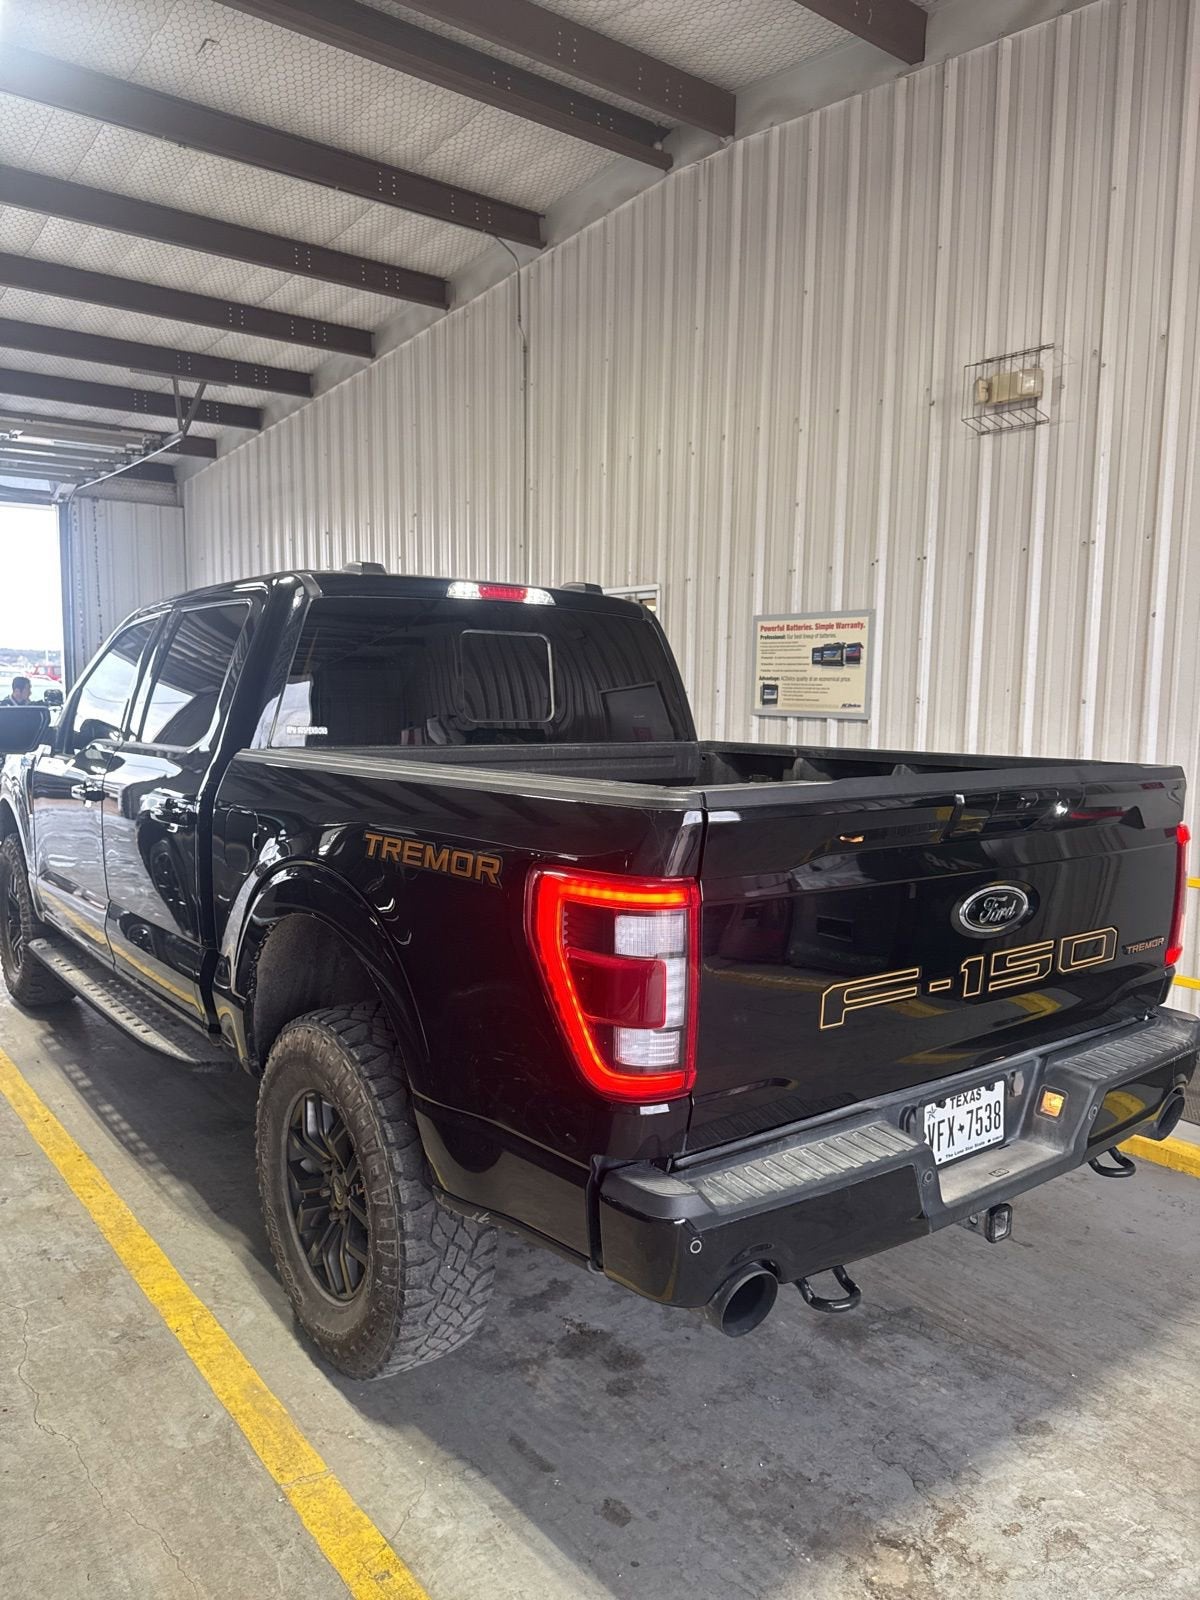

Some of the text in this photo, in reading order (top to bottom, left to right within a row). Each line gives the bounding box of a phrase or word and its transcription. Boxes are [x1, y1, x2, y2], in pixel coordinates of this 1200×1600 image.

[760, 624, 785, 632] Powerful
[815, 622, 834, 631] Simple
[836, 621, 866, 631] Warranty.
[364, 832, 500, 886] TREMOR
[979, 895, 1017, 924] Ford
[1126, 937, 1165, 954] TREMOR
[819, 926, 1119, 1031] F-150
[949, 1088, 982, 1110] TEXAS
[927, 1100, 1001, 1152] VFX 7538
